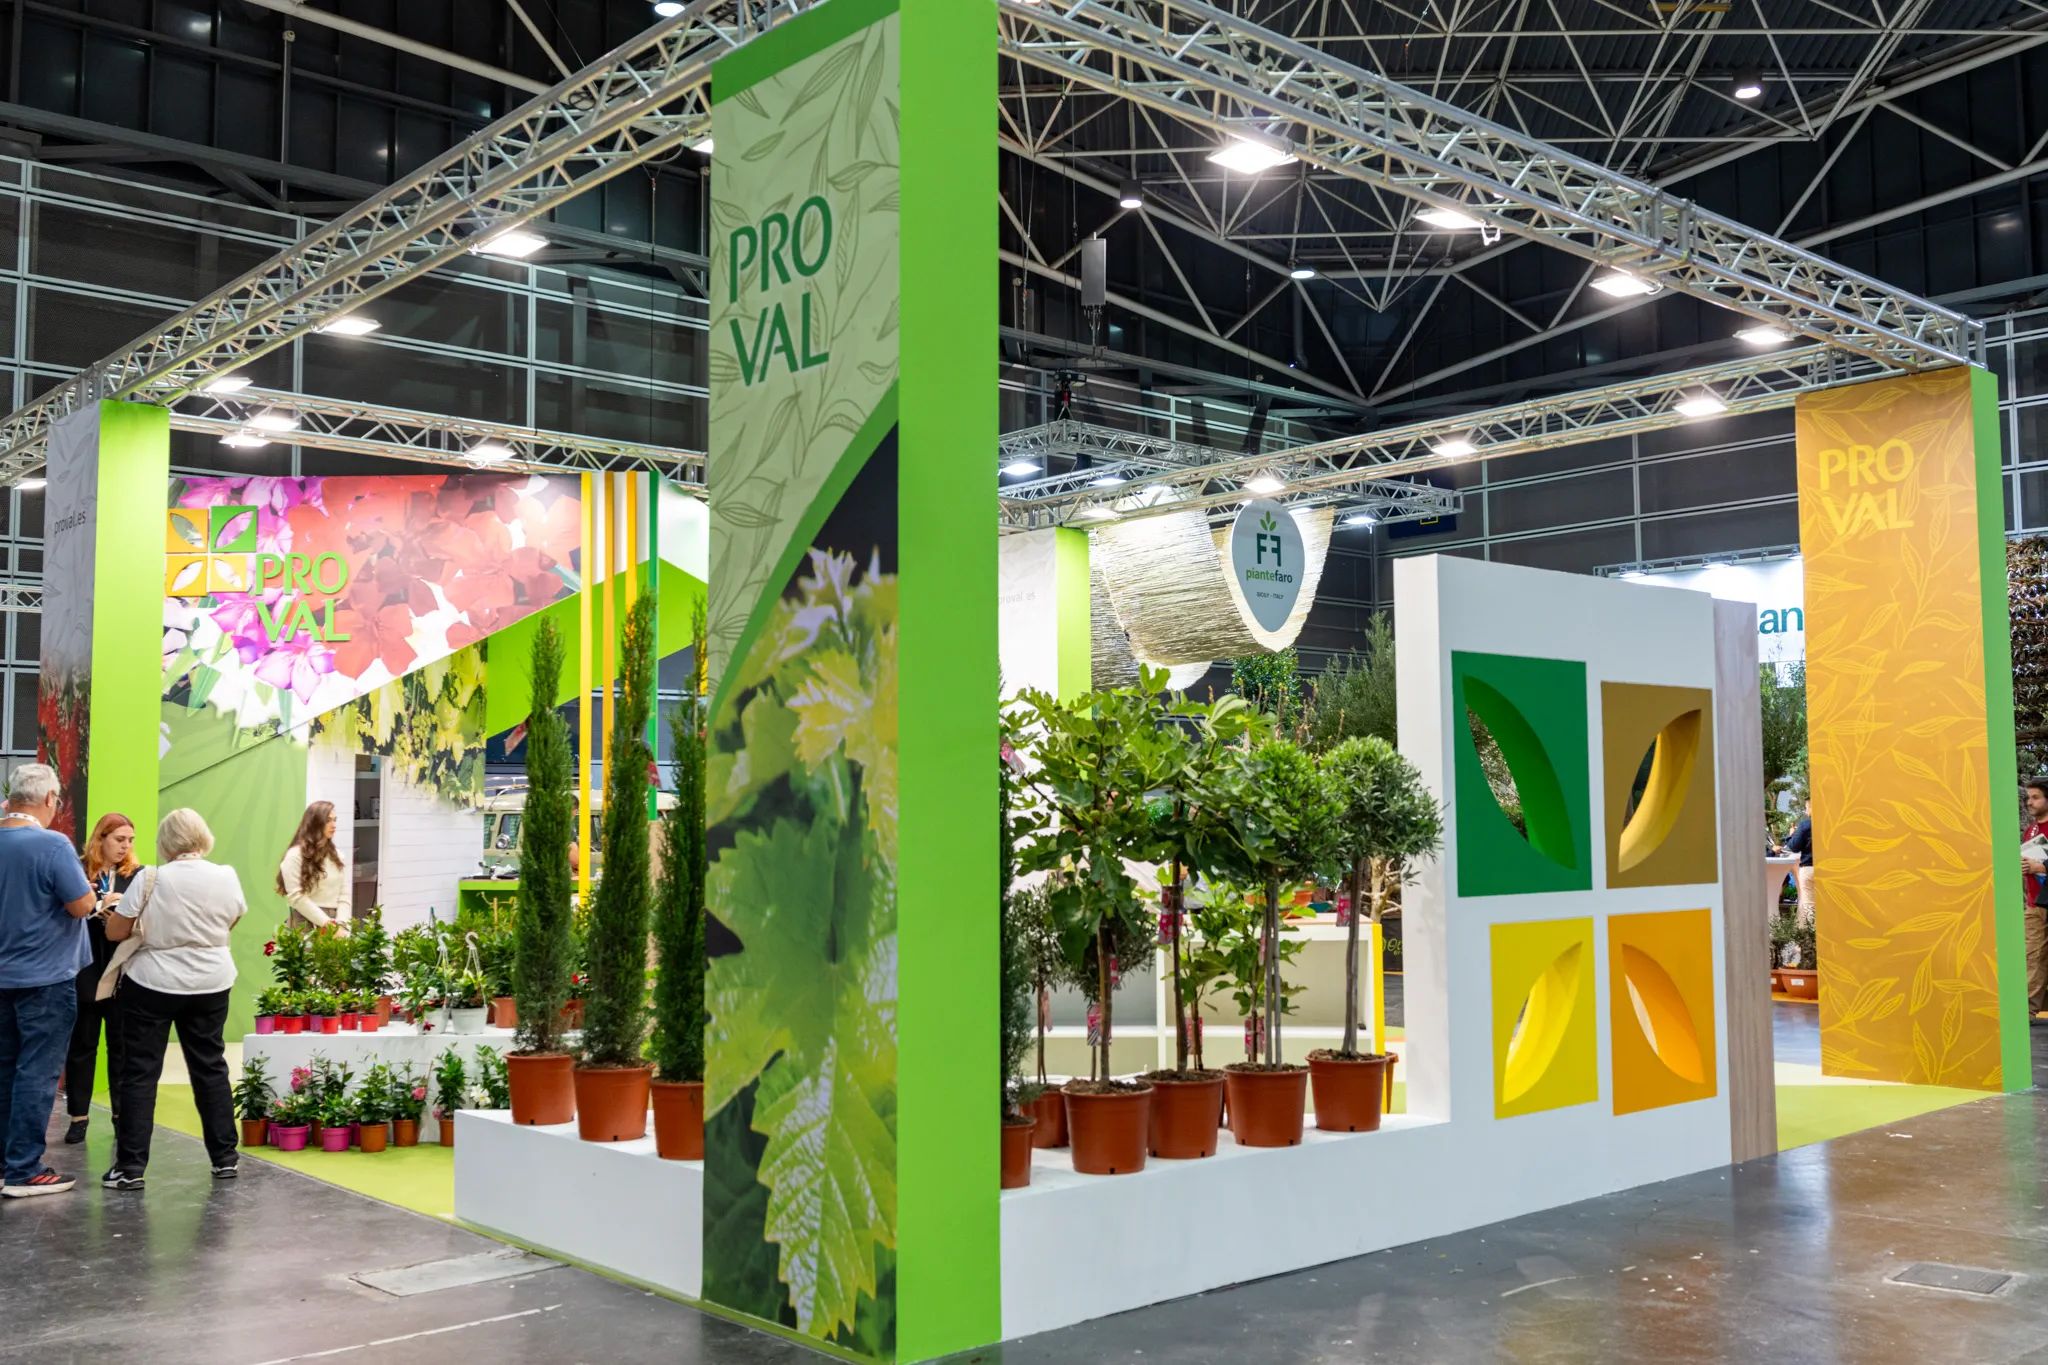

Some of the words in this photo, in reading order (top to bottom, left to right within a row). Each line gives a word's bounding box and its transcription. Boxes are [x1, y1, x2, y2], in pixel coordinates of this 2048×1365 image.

[730, 196, 832, 304] PRO
[730, 292, 829, 387] VAL
[1819, 440, 1914, 491] PRO
[54, 510, 86, 539] proval.es
[1821, 488, 1914, 535] VAL
[255, 551, 349, 596] PRO
[1246, 567, 1293, 583] piantefaro
[255, 599, 351, 643] VAL
[1757, 607, 1804, 634] an
